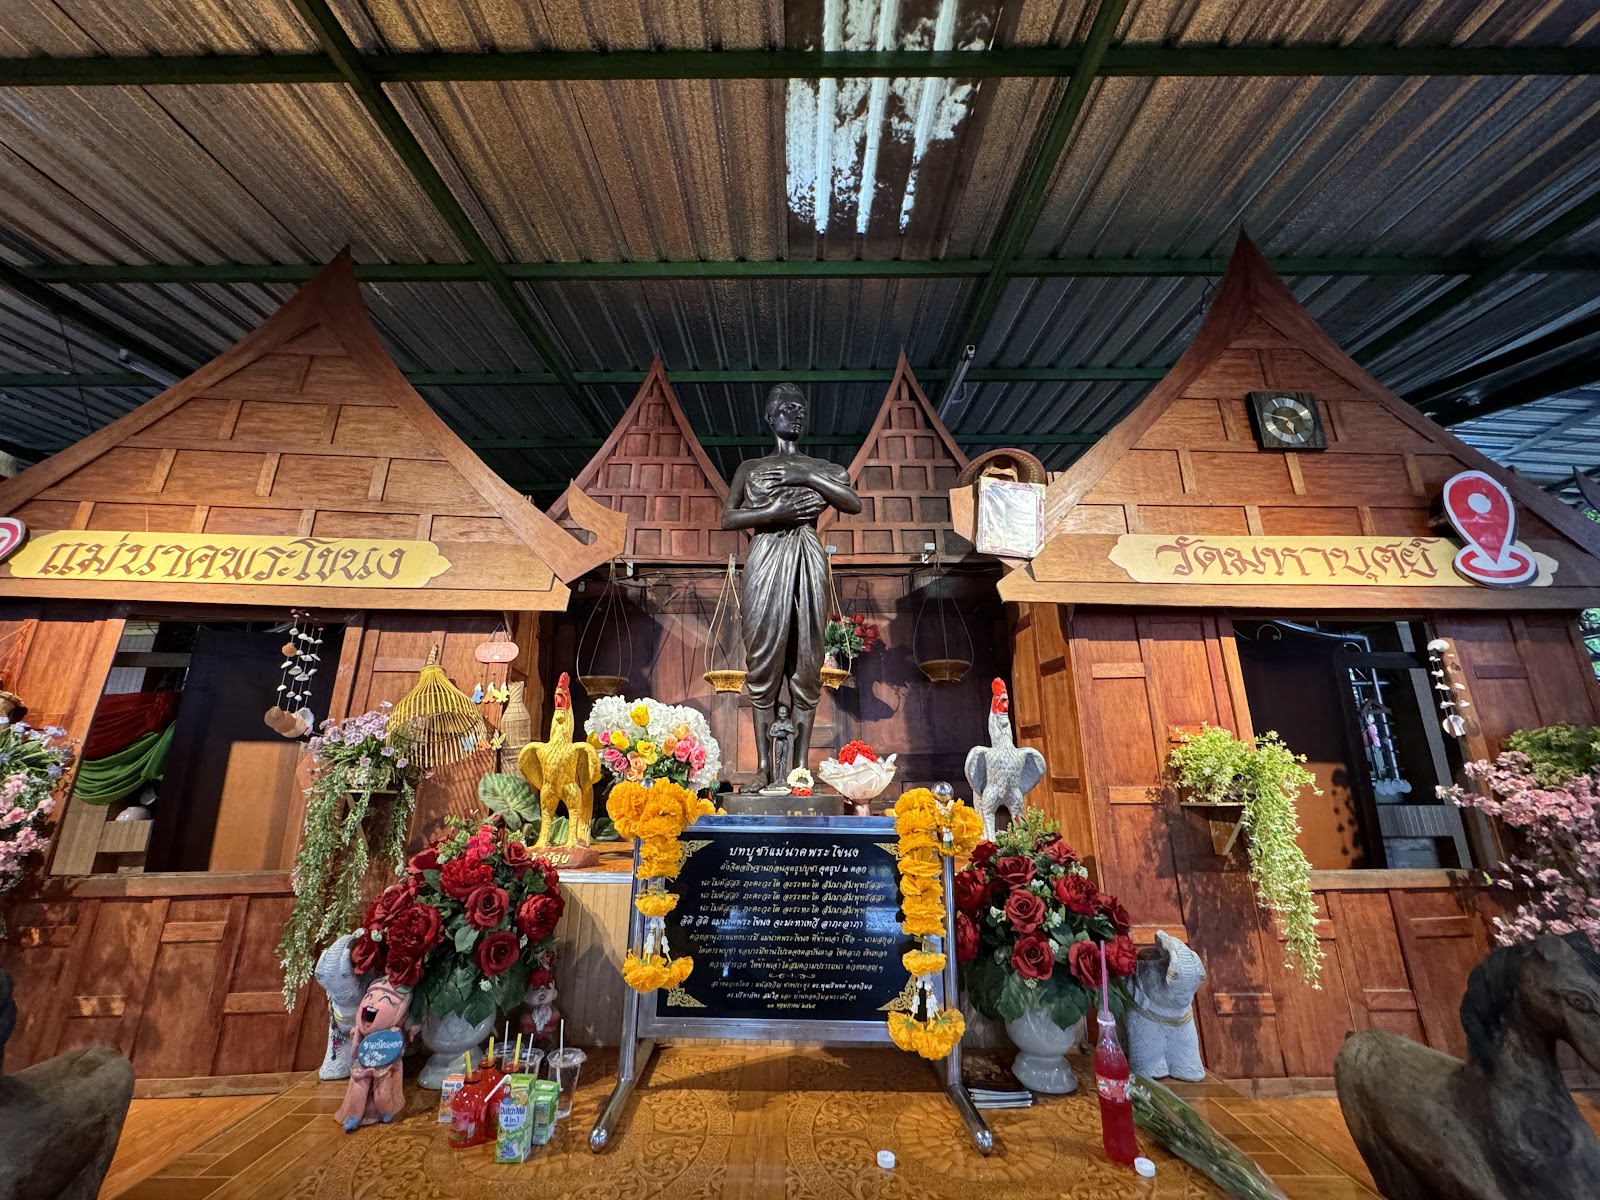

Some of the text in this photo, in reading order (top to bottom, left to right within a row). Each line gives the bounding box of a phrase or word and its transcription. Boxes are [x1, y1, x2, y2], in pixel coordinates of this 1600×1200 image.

[38, 532, 406, 583] แม่นาคพระโขนง
[1155, 535, 1441, 583] วัดมหาบุศย์
[500, 1106, 526, 1115] Dutch Mill
[509, 1115, 516, 1123] in
